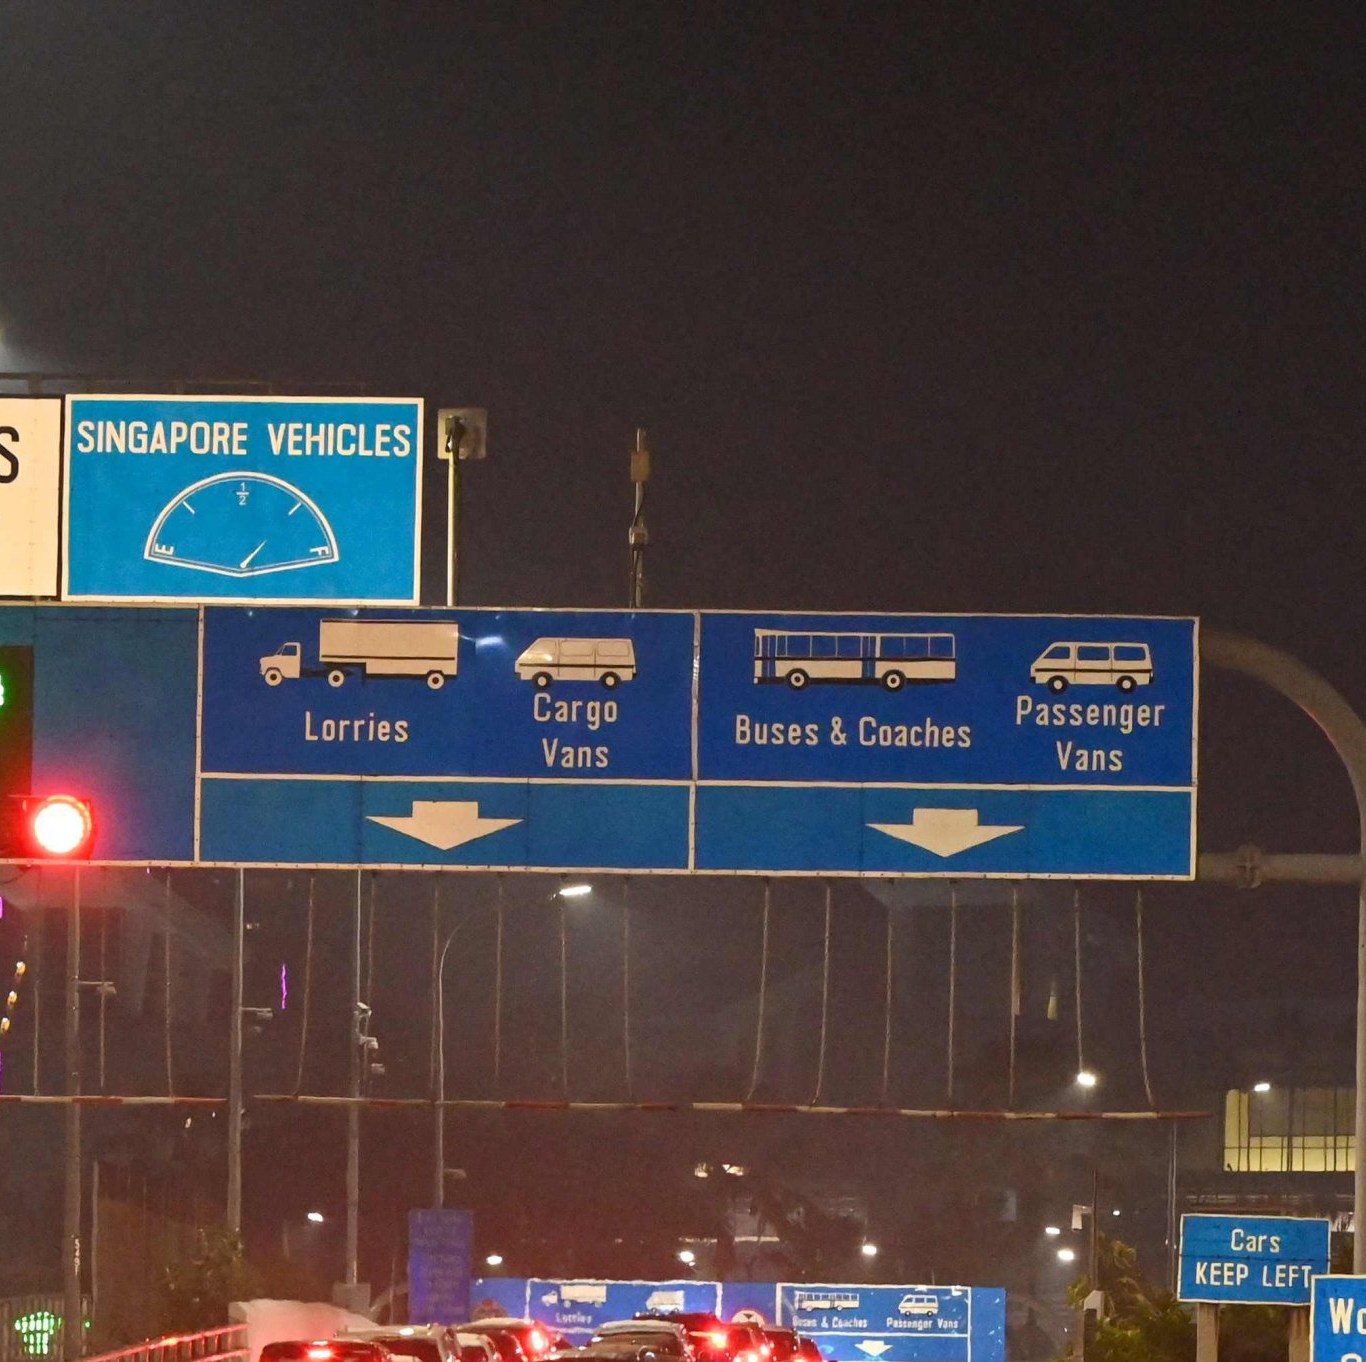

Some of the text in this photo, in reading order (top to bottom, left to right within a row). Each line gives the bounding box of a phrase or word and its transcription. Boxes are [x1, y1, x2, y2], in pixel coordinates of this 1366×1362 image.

[77, 420, 411, 457] SINGAPORE VEHICLES
[533, 692, 618, 727] Cargo
[1016, 695, 1165, 732] Passenger
[305, 711, 409, 743] Lorries
[735, 714, 971, 748] Buses & Coaches
[542, 737, 609, 768] Vans
[1056, 740, 1123, 771] Vans
[1230, 1228, 1281, 1253] Cars
[1195, 1261, 1313, 1289] KEEP LEFT
[886, 1317, 959, 1331] Passenger Vans
